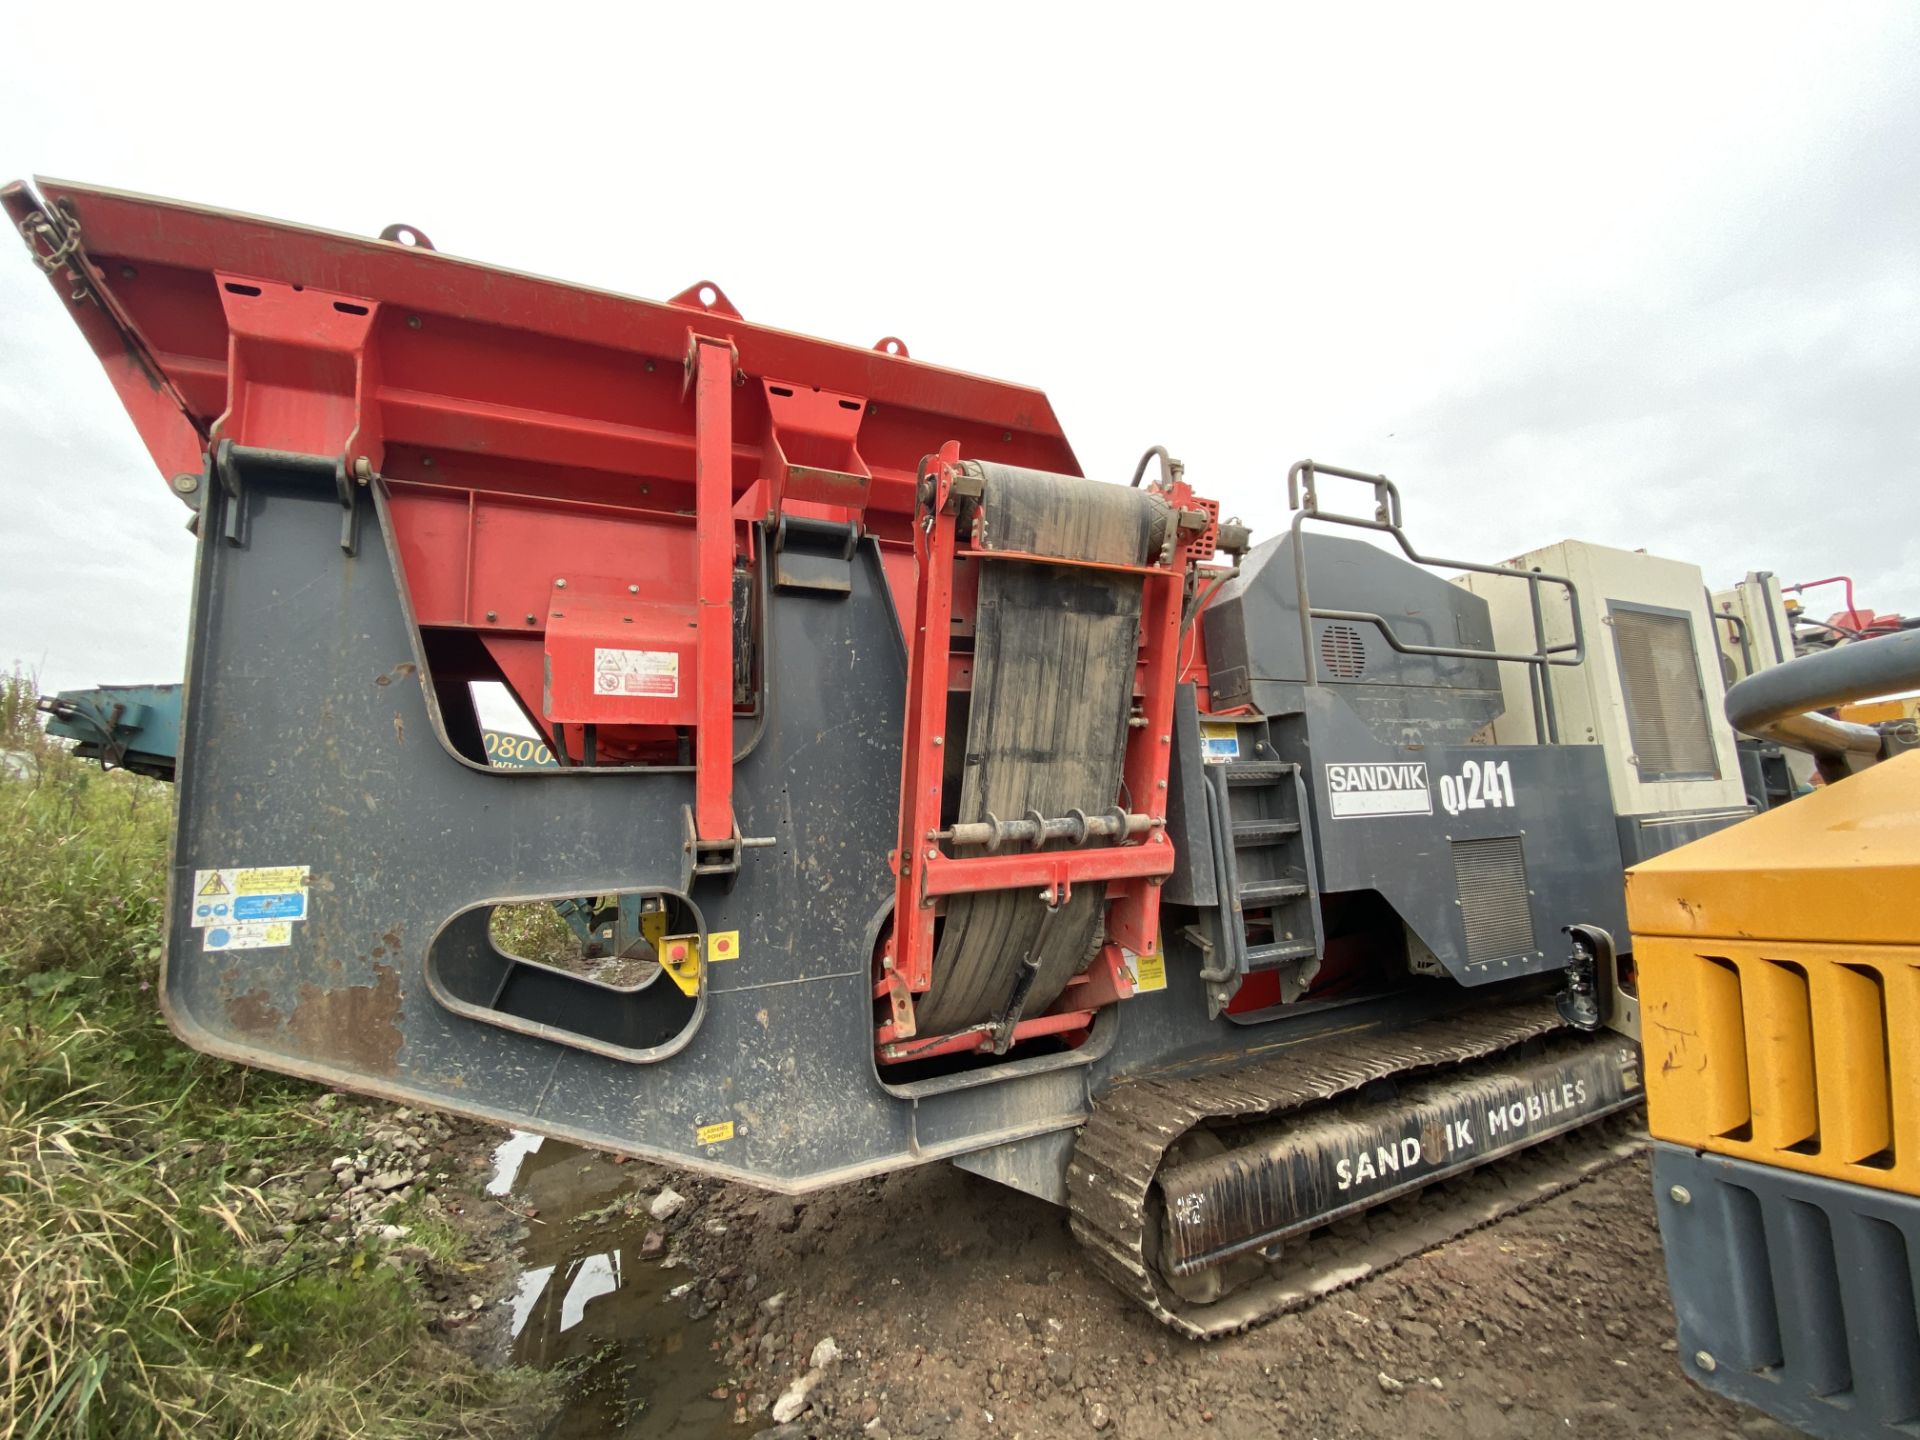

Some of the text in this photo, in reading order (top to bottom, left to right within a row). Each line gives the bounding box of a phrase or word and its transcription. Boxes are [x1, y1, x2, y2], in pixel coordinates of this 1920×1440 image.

[1329, 765, 1426, 792] SANDVIK
[1439, 759, 1516, 816] QJ241
[1336, 1079, 1587, 1190] SANDIK MOBILES
